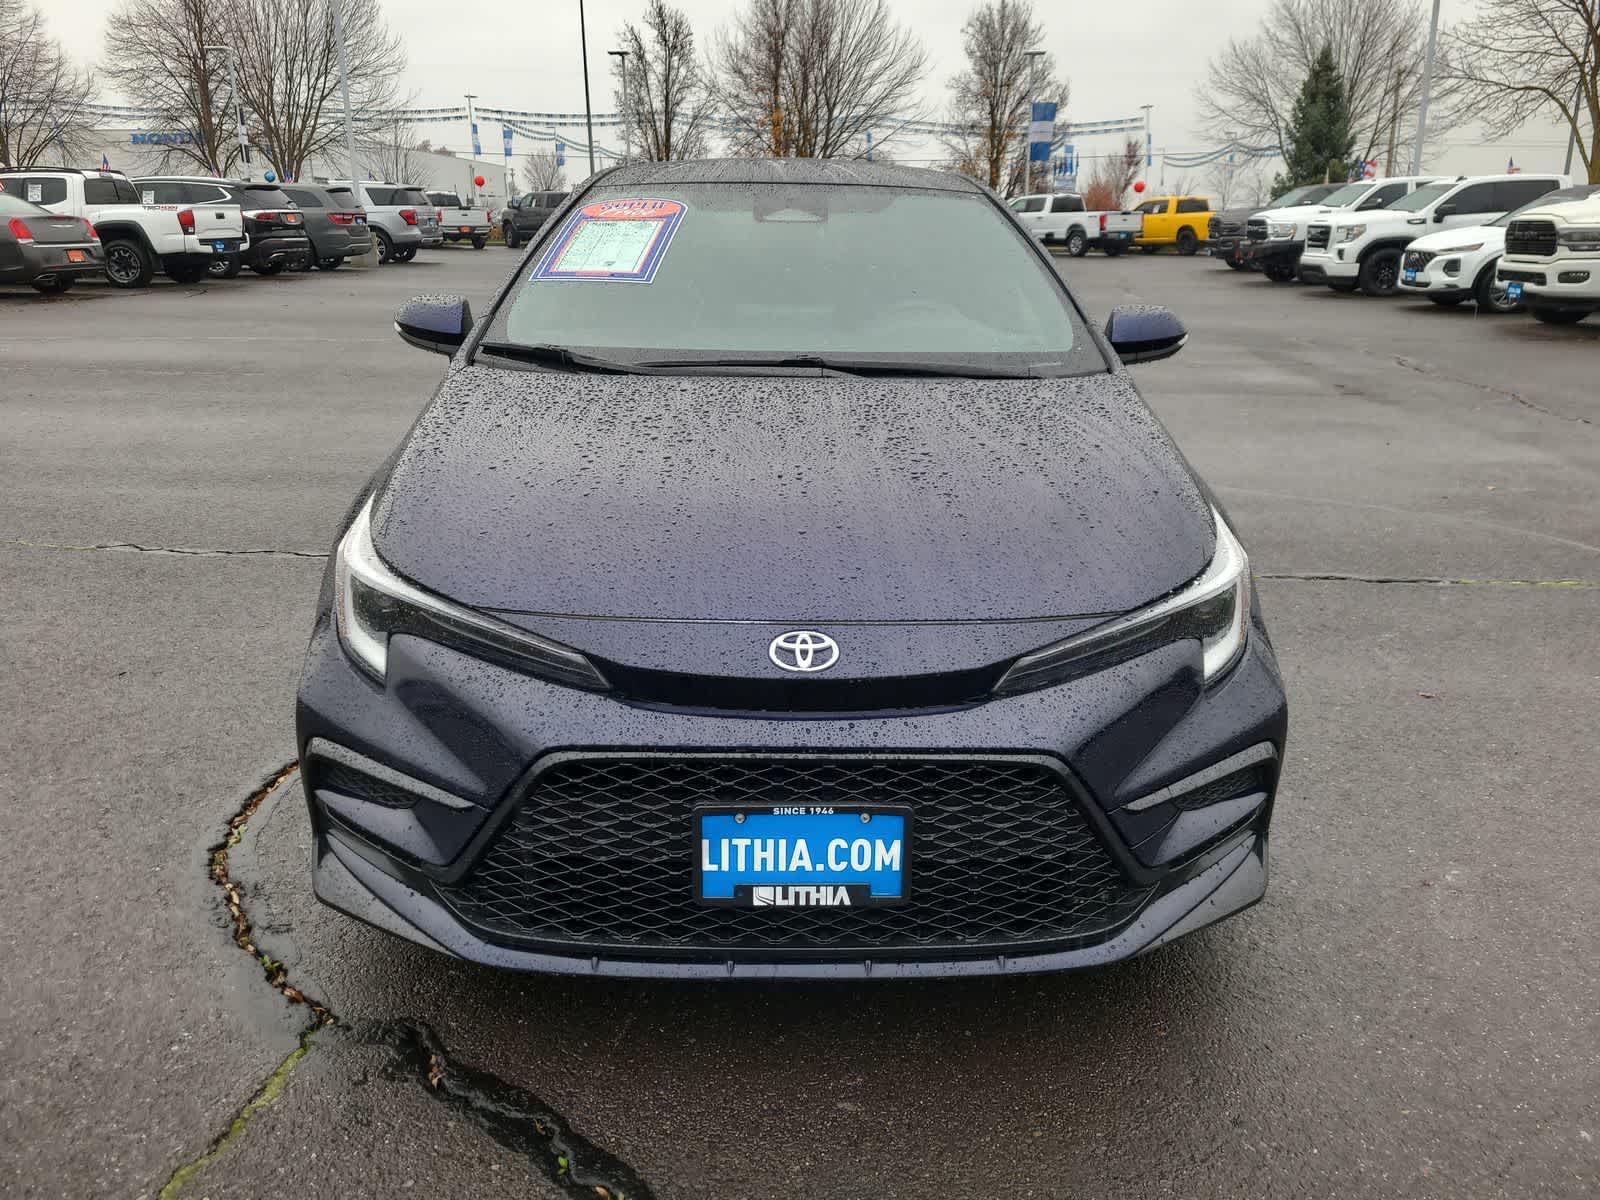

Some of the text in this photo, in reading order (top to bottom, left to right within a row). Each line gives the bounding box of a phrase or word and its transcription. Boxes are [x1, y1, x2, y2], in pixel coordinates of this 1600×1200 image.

[773, 807, 834, 815] SINCE 1946
[701, 838, 901, 872] LITHIA.COM
[775, 886, 851, 906] LITHIA
